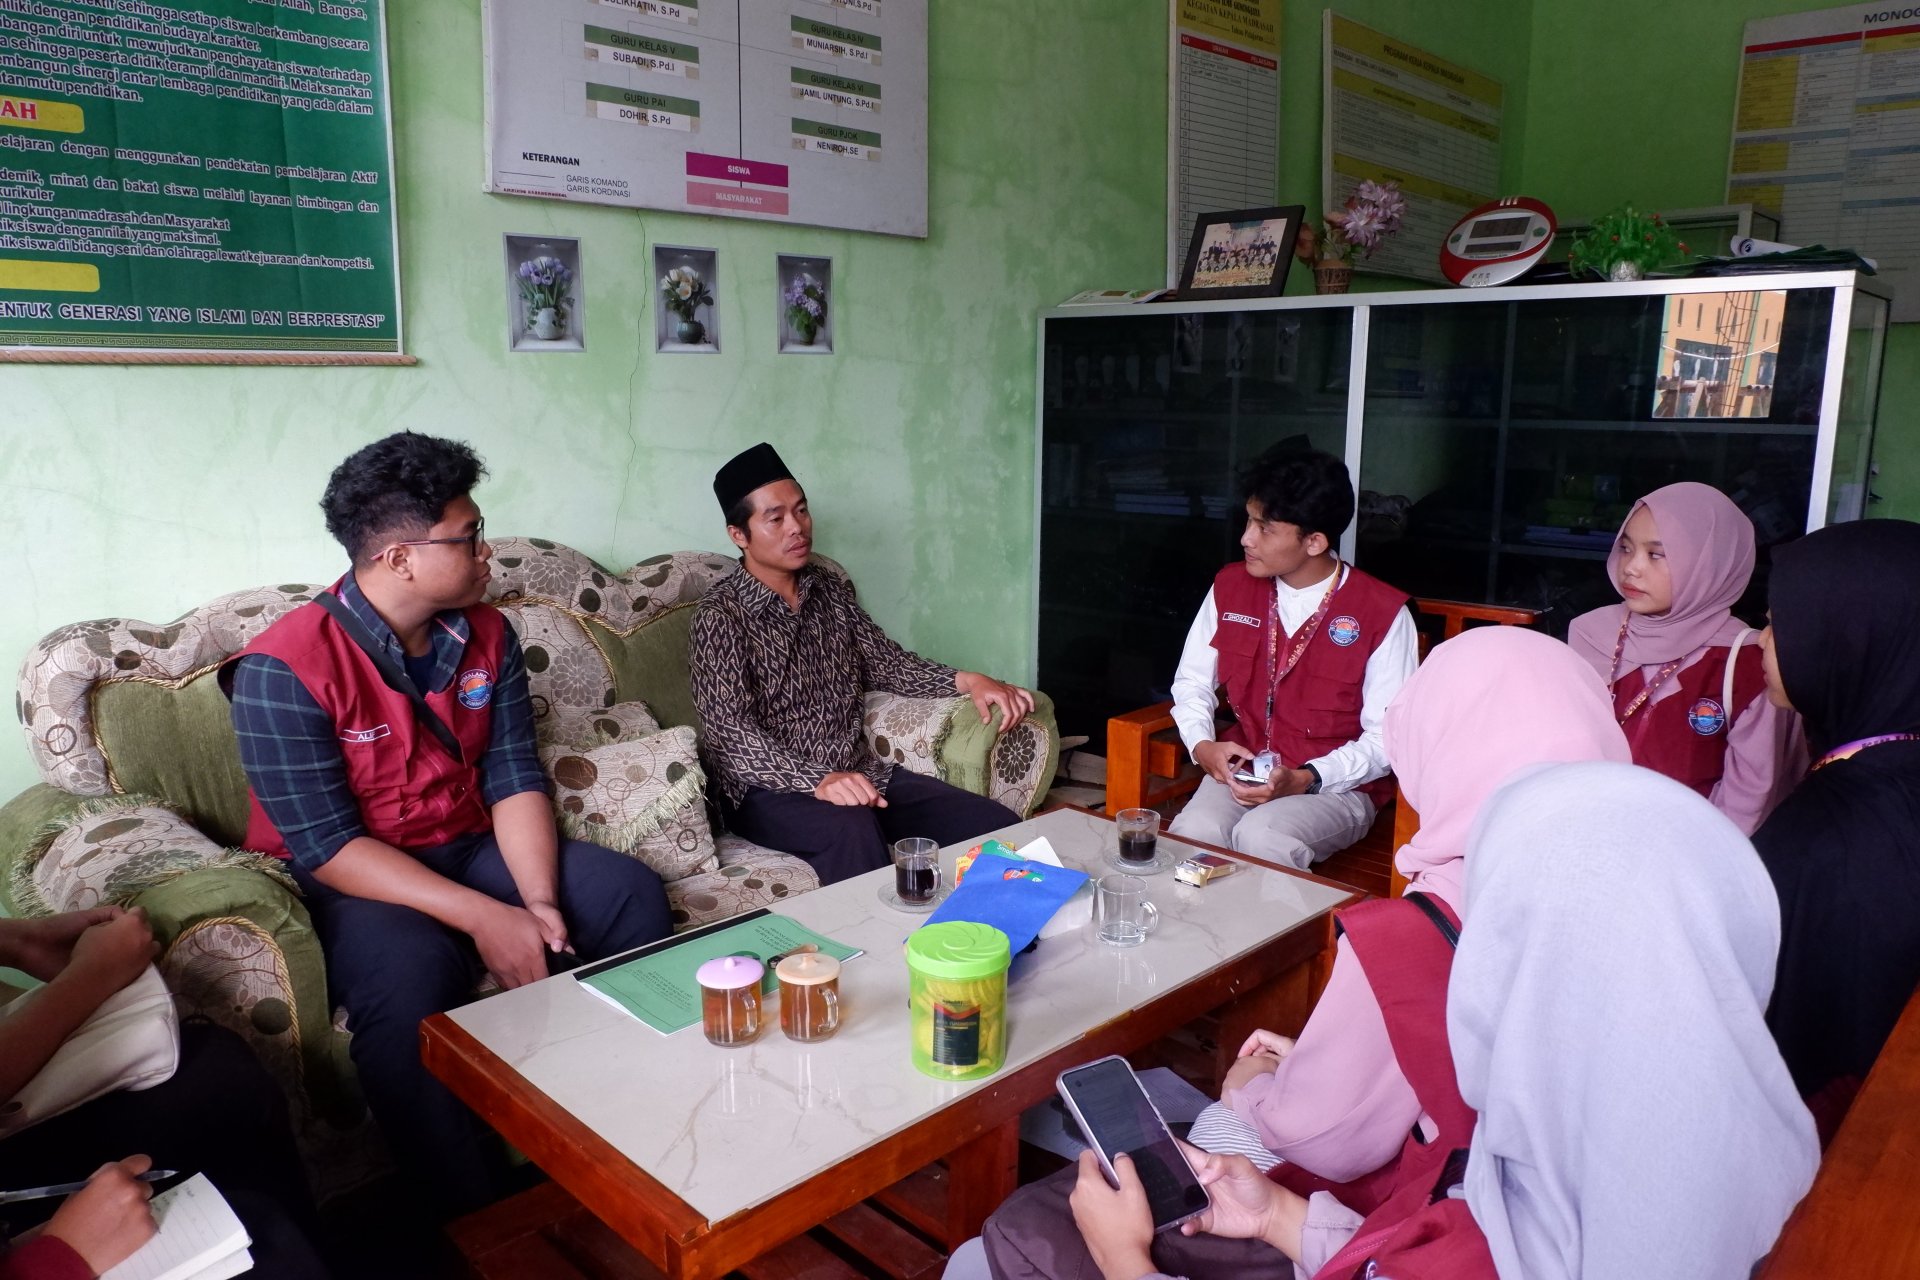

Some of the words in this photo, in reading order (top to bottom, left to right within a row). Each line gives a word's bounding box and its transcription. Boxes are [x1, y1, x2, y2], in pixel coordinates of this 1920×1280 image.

[319, 1, 367, 20] Bangsa,
[661, 6, 680, 17] S.Pd
[33, 2, 86, 23] dengan
[87, 12, 162, 35] pendidikan
[162, 22, 209, 43] budaya
[210, 31, 261, 52] karakter.
[117, 1, 179, 21] sehingga
[180, 11, 219, 28] setiap
[220, 16, 255, 34] siswa
[256, 22, 328, 48] berkembang
[329, 37, 369, 51] secara
[811, 24, 831, 36] GURU
[833, 29, 857, 42] KELAS
[857, 34, 864, 44] IV
[0, 14, 56, 36] bangan
[58, 24, 81, 40] diri
[83, 29, 122, 47] untuk
[126, 36, 207, 60] mewujudkan
[210, 48, 284, 72] penghayatan
[285, 61, 318, 77] siswa
[319, 66, 372, 85] terhadap
[610, 34, 636, 47] GURU
[638, 39, 668, 54] KELAS
[669, 46, 676, 54] V
[10, 37, 77, 58] sehingga
[78, 46, 128, 65] peserta
[129, 55, 163, 70] didik
[164, 60, 216, 78] terampil
[218, 68, 241, 82] dan
[242, 73, 288, 89] mandiri.
[289, 78, 372, 99] Melaksanakan
[0, 53, 70, 74] mbangun
[72, 63, 120, 83] sinergi
[121, 72, 157, 86] antar
[159, 75, 213, 95] lembaga
[216, 85, 281, 104] pendidikan
[282, 95, 311, 111] yang
[313, 98, 335, 111] ada
[337, 100, 373, 115] dalam
[0, 70, 25, 87] tan
[27, 75, 64, 92] mutu
[65, 81, 143, 102] pendidikan.
[800, 88, 821, 99] JAMIL
[810, 74, 831, 86] GURU
[832, 77, 856, 91] KELAS
[857, 84, 864, 93] VI
[624, 92, 649, 105] GURU
[651, 98, 666, 108] PAI
[651, 114, 671, 125] S.Pd
[818, 126, 838, 137] GURU
[840, 130, 858, 140] PJOK
[0, 134, 54, 152] elajaran
[60, 141, 109, 159] dengan
[115, 148, 200, 166] menggunakan
[205, 157, 271, 174] pendekatan
[275, 165, 346, 183] pembelajaran
[351, 171, 378, 184] Aktif
[522, 151, 580, 166] KETERANGAN
[727, 164, 751, 175] SISWA
[566, 175, 589, 184] GARIS
[591, 177, 629, 189] KOMANDO
[566, 184, 590, 194] GARIS
[592, 187, 631, 198] KORDINASI
[49, 173, 88, 188] minat
[93, 176, 118, 191] dan
[123, 178, 160, 195] bakat
[163, 184, 200, 197] siswa
[204, 187, 245, 202] melalui
[249, 191, 292, 206] layanan
[296, 195, 353, 213] bimbingan
[357, 201, 379, 213] dan
[715, 192, 762, 205] MASYARAKAT
[3, 202, 77, 221] lingkungan
[77, 210, 140, 225] madrasah
[141, 213, 163, 227] dan
[164, 215, 230, 230] Masyarakat
[17, 220, 55, 234] siswa
[55, 223, 104, 239] dengan
[105, 225, 130, 238] nilai
[131, 229, 162, 244] yang
[163, 230, 221, 246] maksimal.
[18, 237, 56, 251] siswa
[57, 238, 71, 251] di
[72, 239, 114, 257] bidang
[115, 243, 142, 256] seni
[143, 244, 167, 257] dan
[168, 244, 216, 261] olahraga
[217, 249, 247, 262] lewat
[247, 250, 299, 266] kejuaraan
[299, 253, 320, 266] dan
[321, 255, 375, 271] kompetisi.
[58, 304, 143, 321] GENERASI
[147, 307, 192, 322] YANG
[196, 308, 246, 324] ISLAMI
[252, 310, 282, 325] DAN
